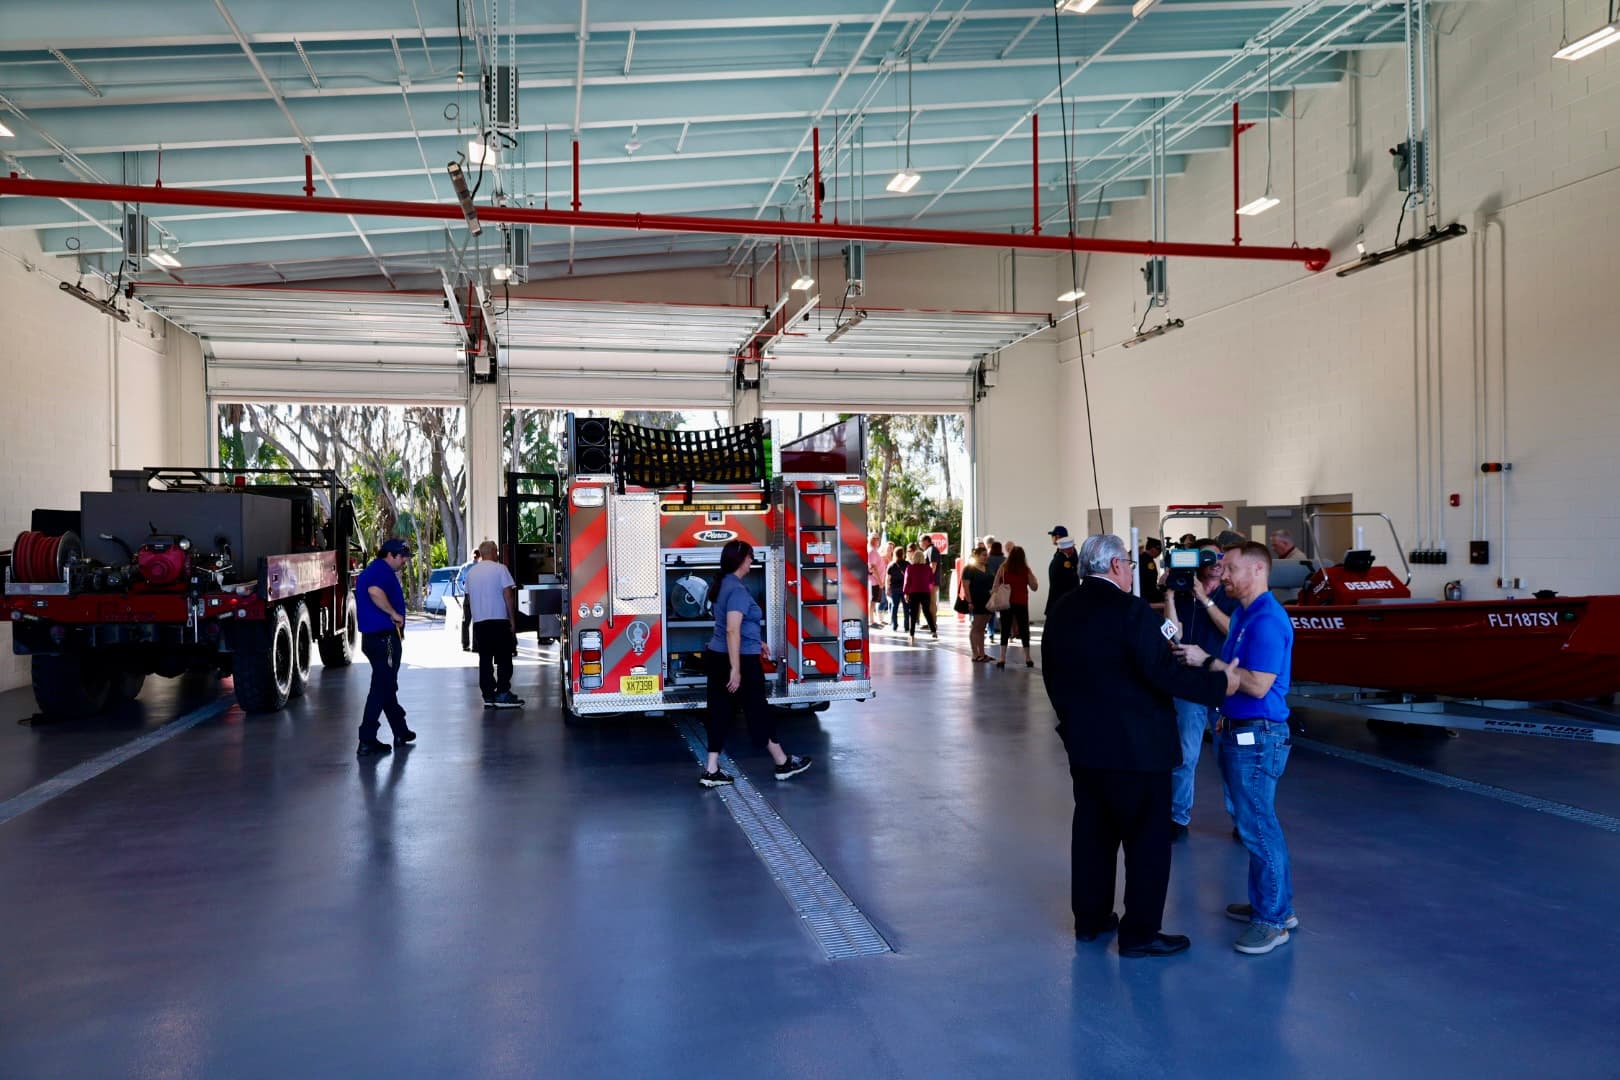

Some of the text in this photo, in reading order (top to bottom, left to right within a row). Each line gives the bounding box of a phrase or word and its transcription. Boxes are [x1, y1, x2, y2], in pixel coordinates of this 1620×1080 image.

[1344, 580, 1395, 591] DEBARY
[1290, 617, 1346, 629] ESCUE
[1488, 612, 1559, 628] FL7187SY
[1485, 720, 1536, 728] ROAD
